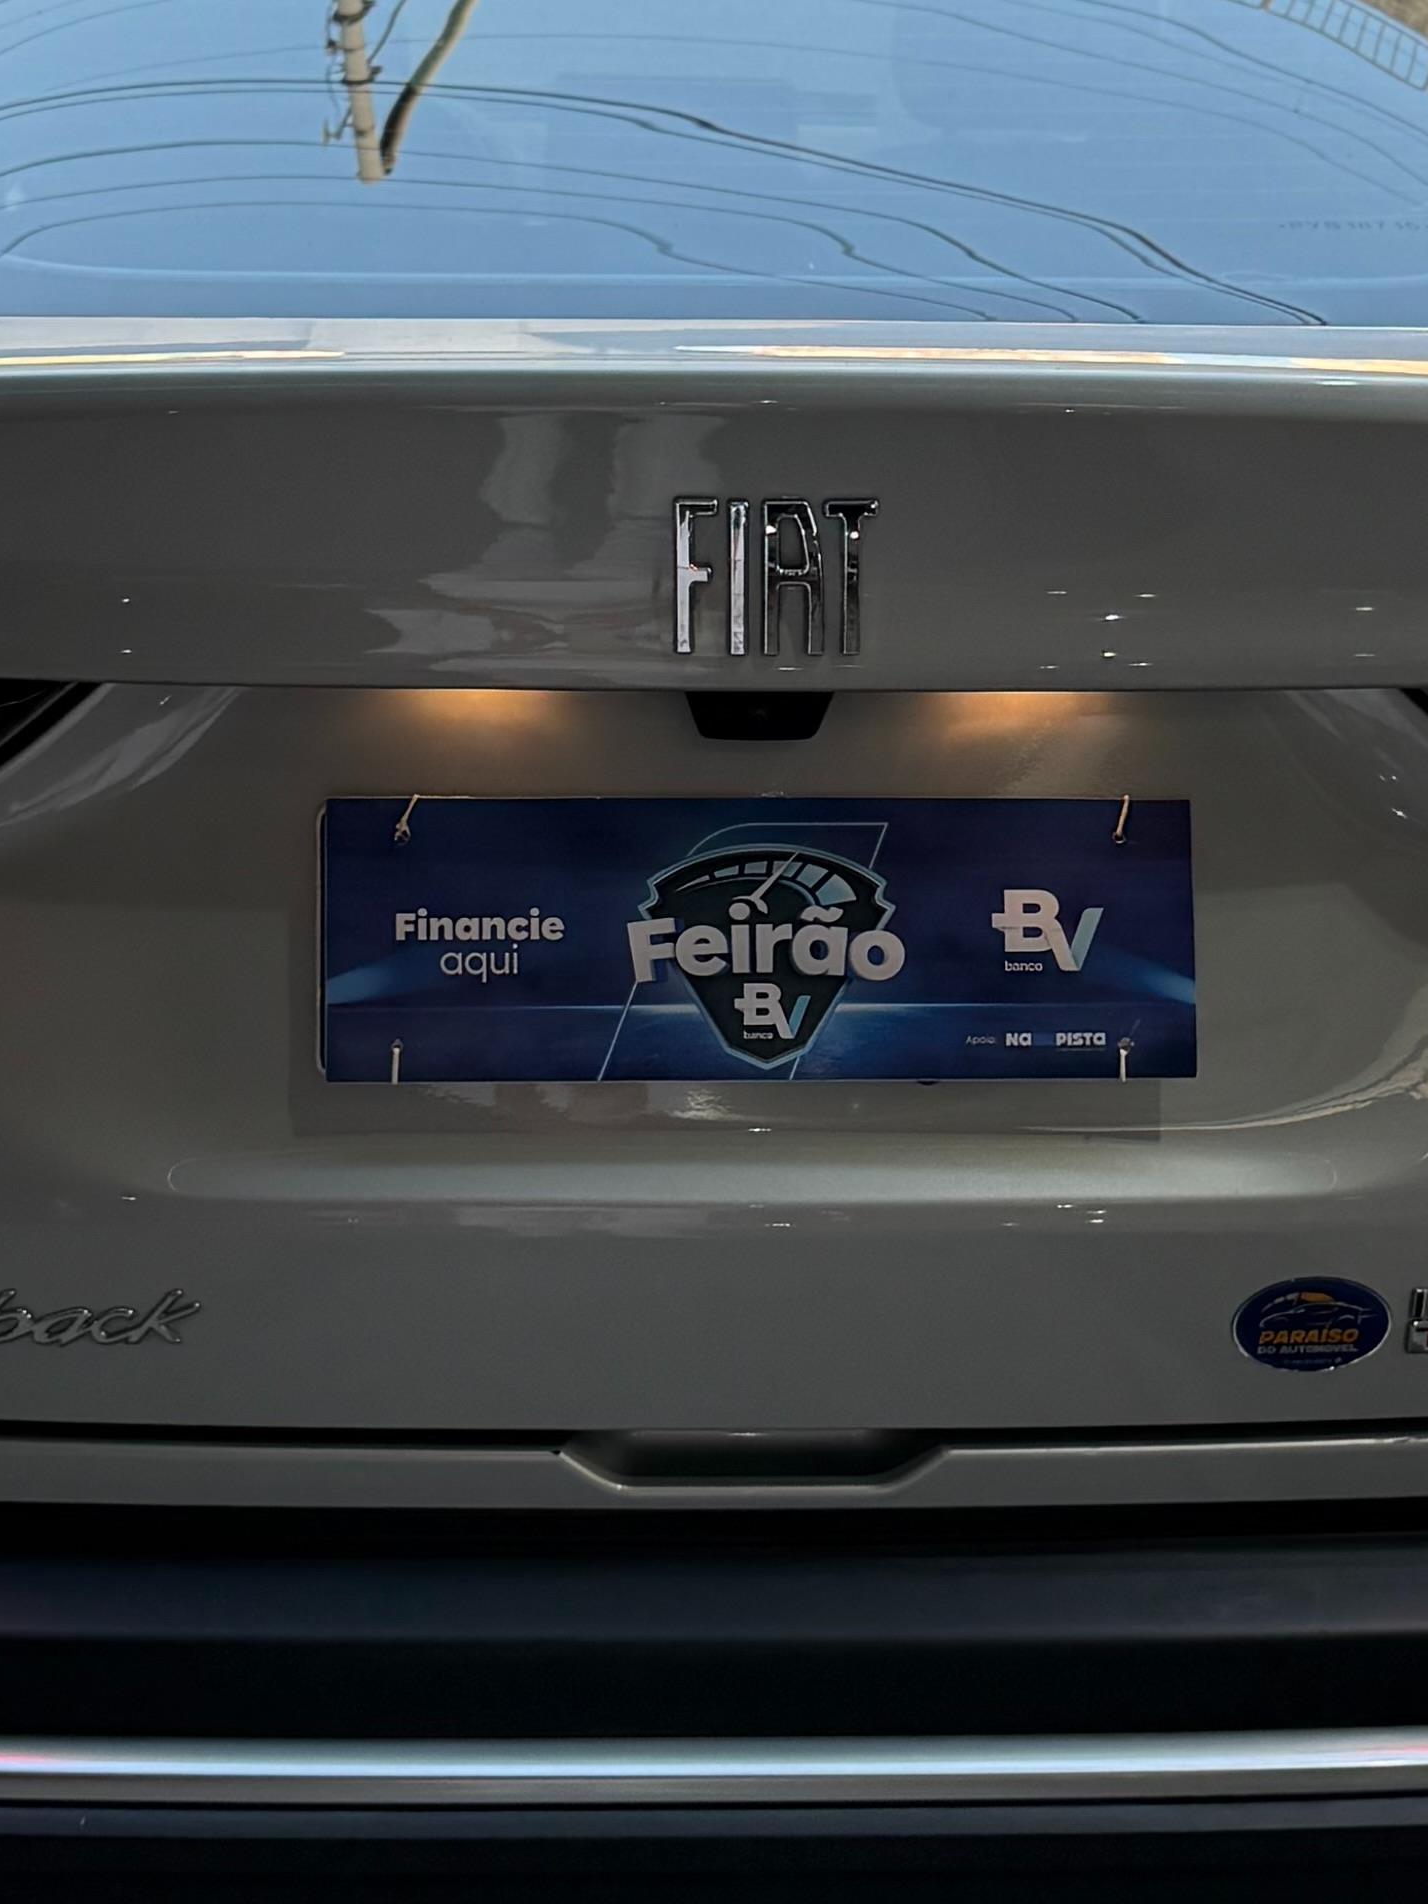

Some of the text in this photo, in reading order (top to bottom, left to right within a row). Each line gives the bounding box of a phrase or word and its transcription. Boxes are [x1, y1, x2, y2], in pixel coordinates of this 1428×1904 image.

[674, 498, 880, 655] FIAT
[395, 907, 565, 941] Financie
[627, 902, 906, 983] Feirão
[991, 889, 1105, 972] BV
[440, 943, 518, 983] aqui
[1004, 960, 1044, 972] banco
[734, 982, 812, 1040] BV
[743, 1030, 774, 1040] banco
